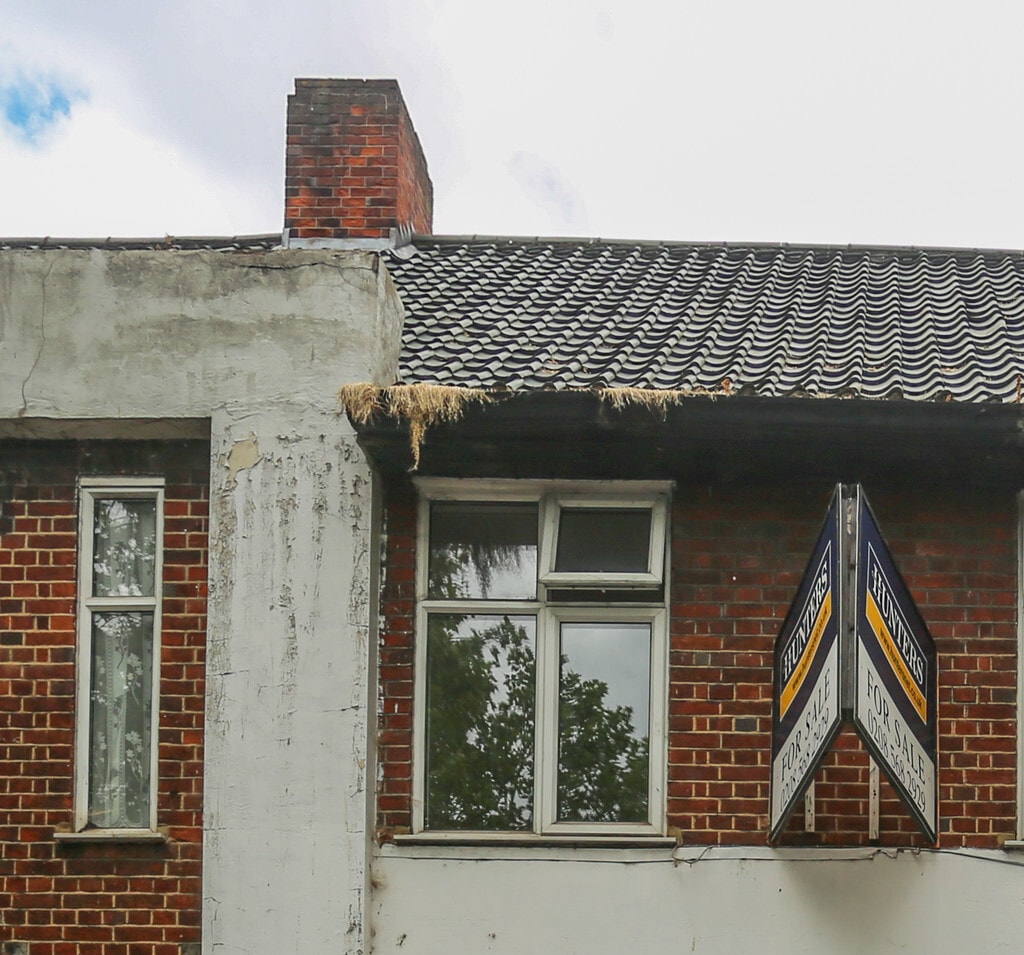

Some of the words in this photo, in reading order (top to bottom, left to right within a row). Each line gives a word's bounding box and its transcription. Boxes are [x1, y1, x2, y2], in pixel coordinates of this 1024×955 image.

[783, 561, 828, 682] HUNTERS
[871, 563, 924, 685] HUNTERS
[781, 730, 801, 783] FOR
[804, 668, 830, 740] SALE
[867, 668, 890, 733] FOR
[895, 719, 926, 785] SALE
[868, 709, 888, 758] 0208
[906, 771, 926, 813] 2929
